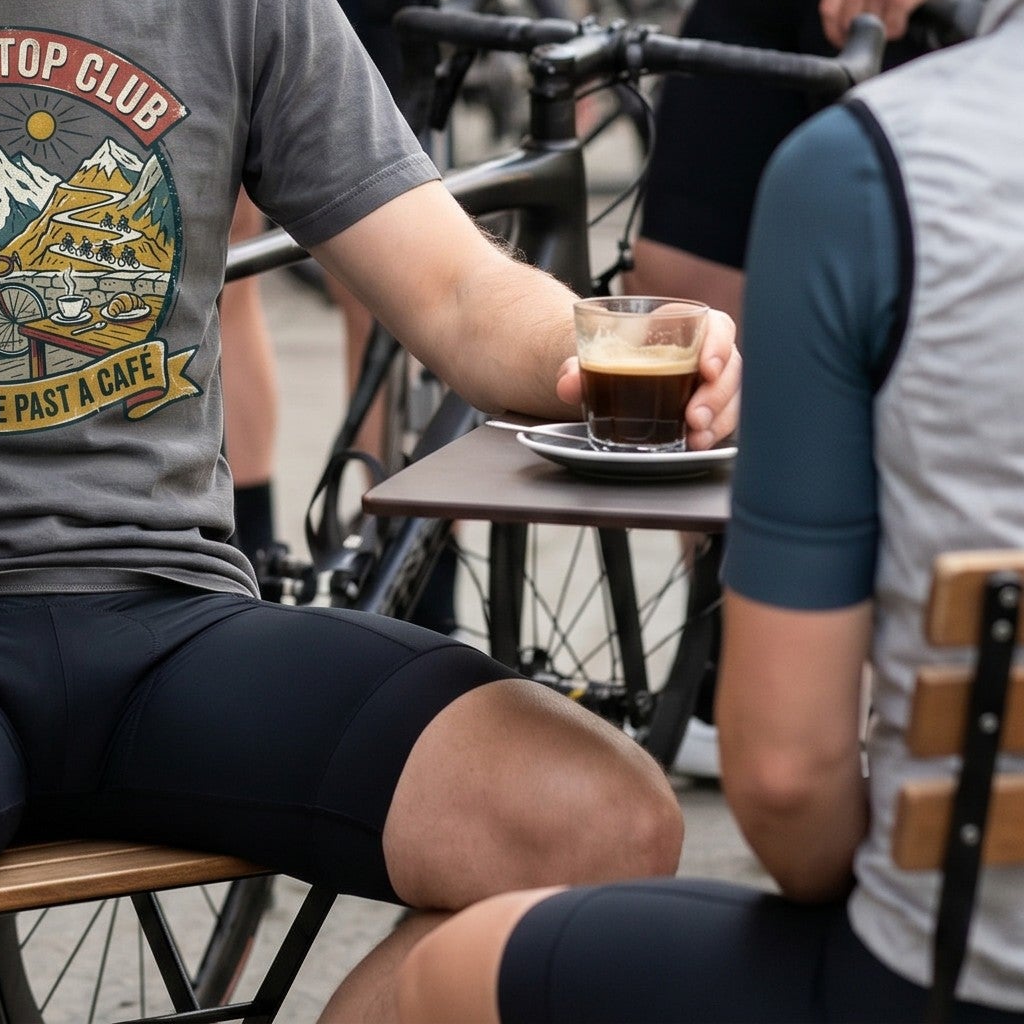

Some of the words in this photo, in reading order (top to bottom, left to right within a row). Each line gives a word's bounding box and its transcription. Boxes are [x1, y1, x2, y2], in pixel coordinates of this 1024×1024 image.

[75, 53, 169, 131] CLUB
[15, 385, 70, 423] PAST
[79, 376, 95, 408] A
[97, 344, 156, 396] CAFÉ
